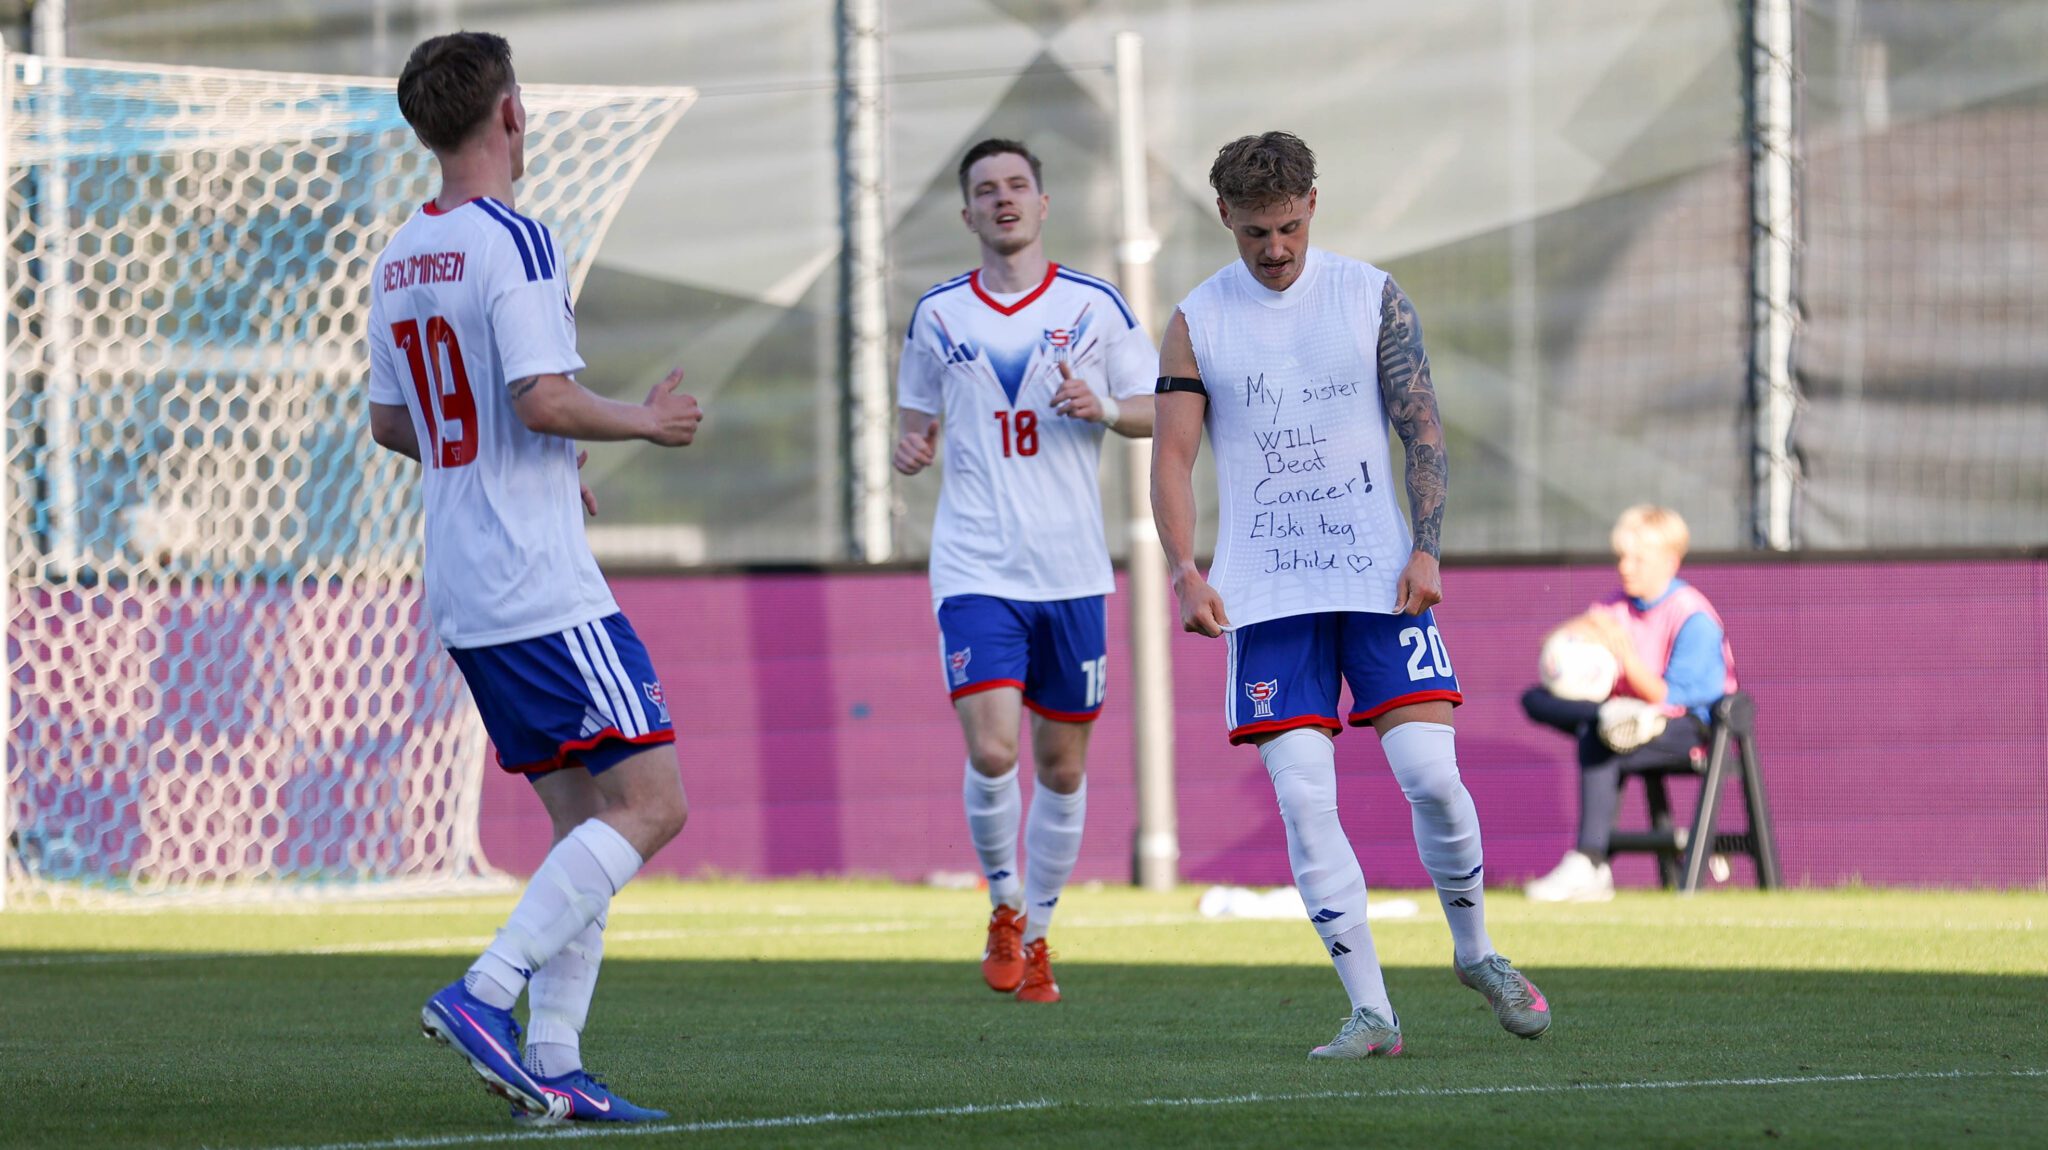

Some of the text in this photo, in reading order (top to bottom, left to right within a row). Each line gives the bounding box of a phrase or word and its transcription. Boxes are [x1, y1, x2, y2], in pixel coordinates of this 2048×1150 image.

[391, 316, 478, 469] 19
[1246, 373, 1360, 424] My sister
[994, 410, 1039, 458] 18
[1254, 425, 1327, 451] WILL
[1253, 461, 1373, 506] Cancer!
[1265, 449, 1327, 474] Beat
[1250, 512, 1355, 545] Elski teg
[1399, 626, 1453, 682] 20
[1081, 655, 1107, 708] 18
